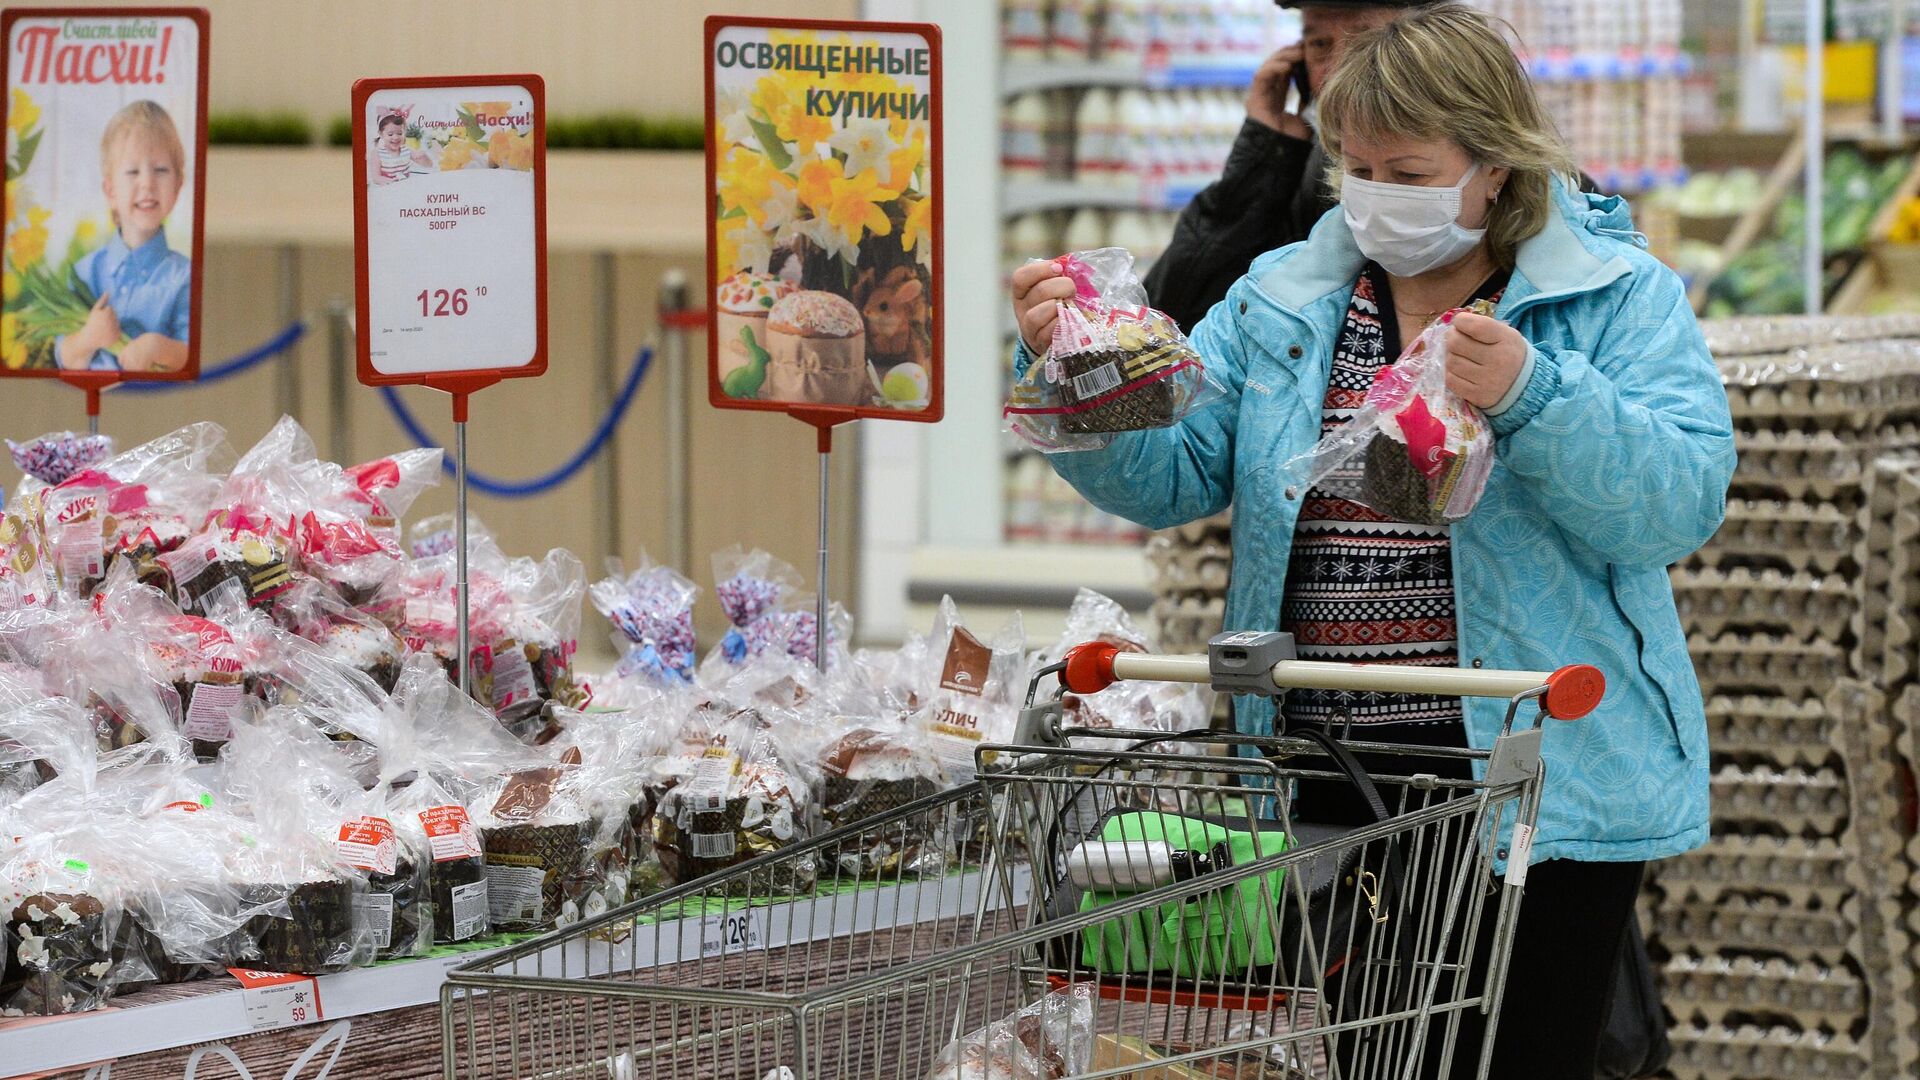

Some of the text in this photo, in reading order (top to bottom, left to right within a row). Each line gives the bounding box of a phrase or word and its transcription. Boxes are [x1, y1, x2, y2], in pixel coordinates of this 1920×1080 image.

[64, 19, 158, 39] Счастливой
[18, 26, 172, 84] Пасхи!
[717, 41, 929, 79] ОСВЯЩЕННЫЕ
[806, 89, 929, 123] КУЛИЧИ
[475, 112, 531, 128] Пасхи!
[427, 193, 459, 204] КУЛИЧ
[400, 205, 486, 218] ПАСХАЛЬНЫЙ ВС
[429, 220, 457, 230] 500ГР
[417, 286, 488, 317] 126 10
[292, 1007, 306, 1021] 59
